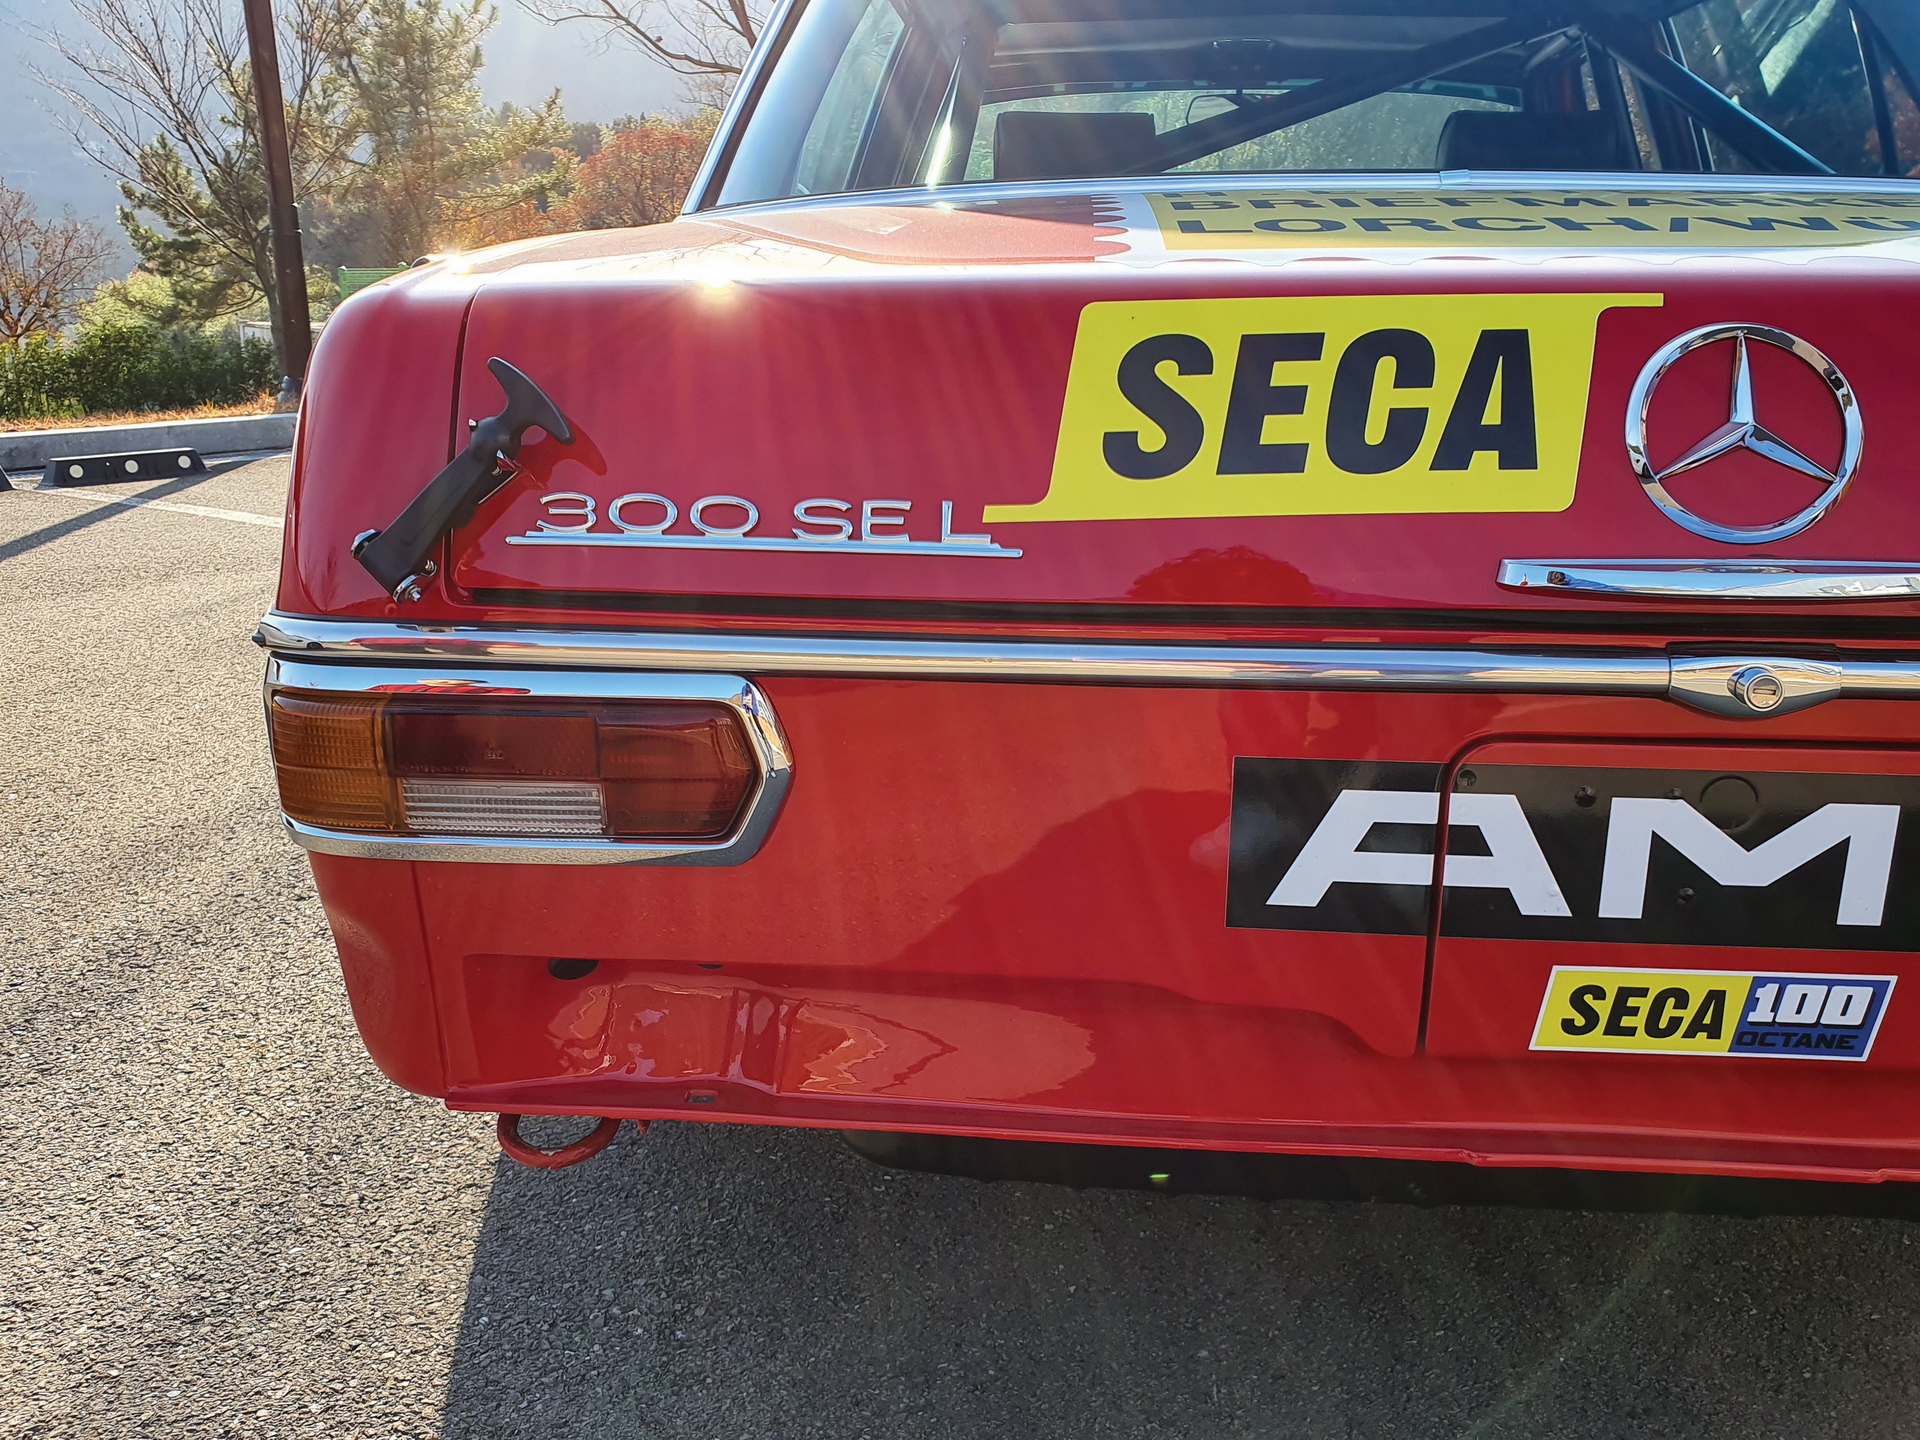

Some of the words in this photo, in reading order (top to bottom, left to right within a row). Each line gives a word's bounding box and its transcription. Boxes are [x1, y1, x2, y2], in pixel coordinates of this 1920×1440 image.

[1102, 328, 1538, 480] SECA
[537, 491, 759, 535] 300
[1266, 789, 1900, 926] AM
[1560, 984, 1727, 1040] SECA
[1746, 982, 1875, 1029] 100
[1735, 1031, 1859, 1050] OCTANE
